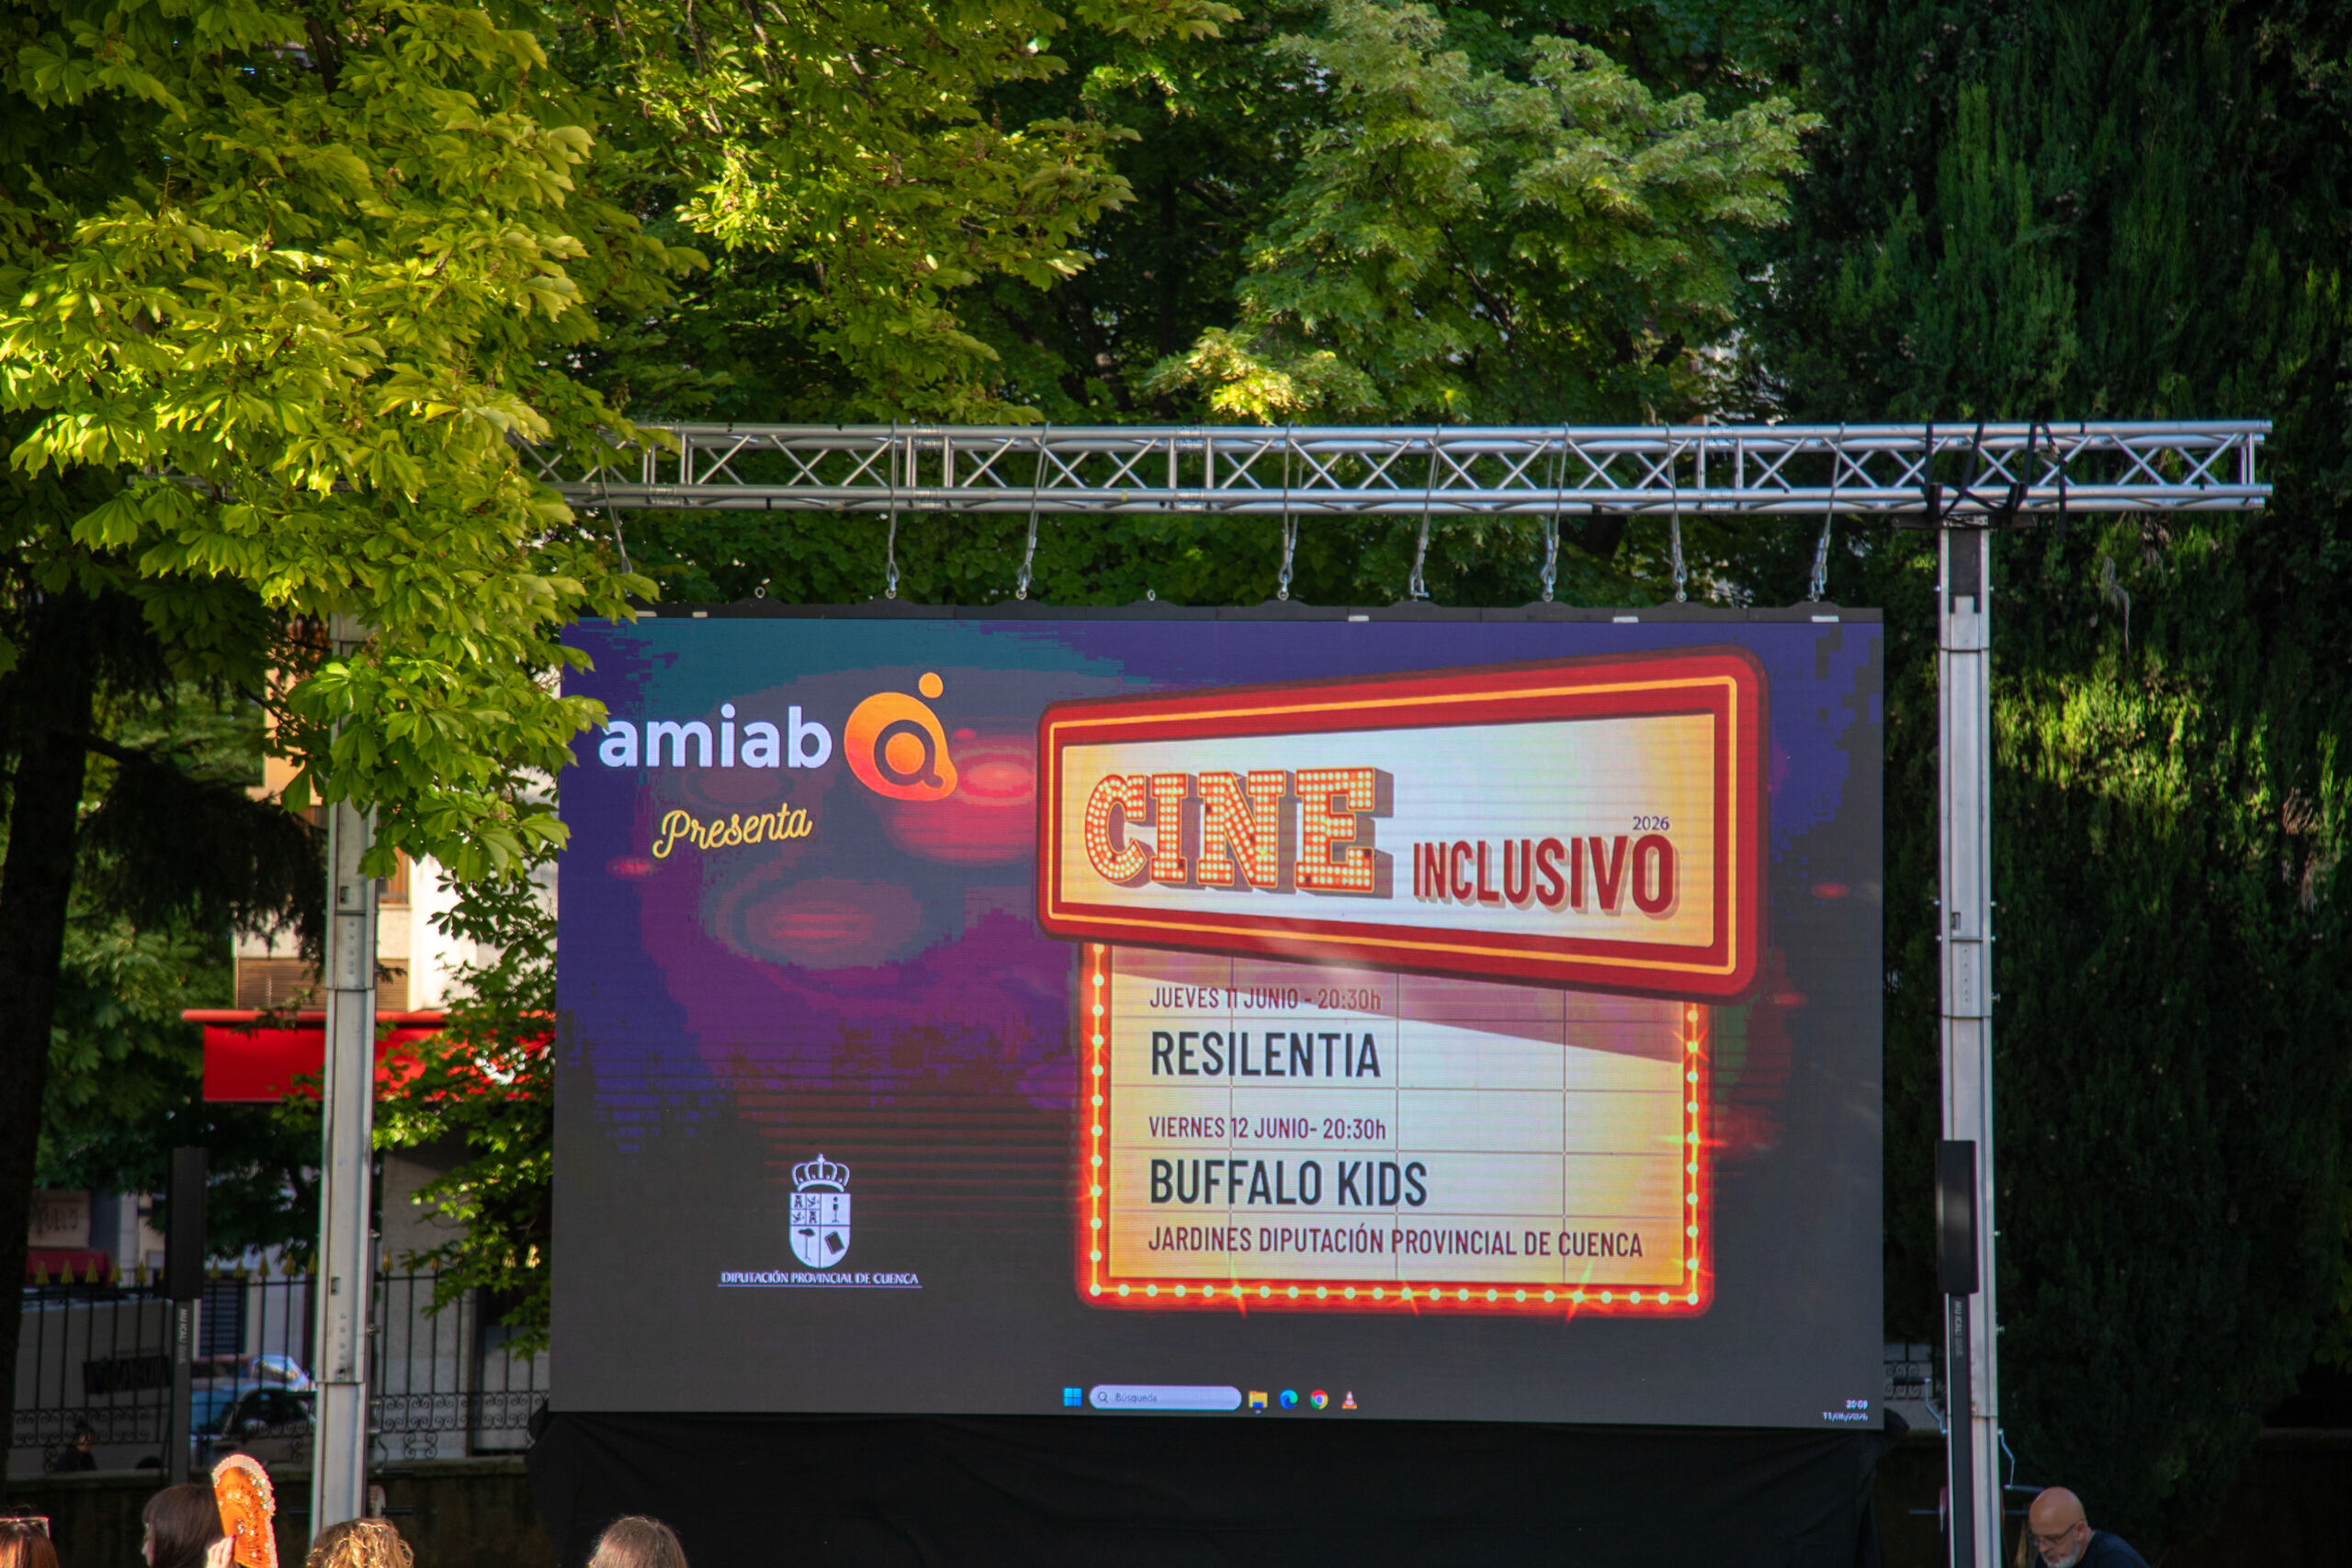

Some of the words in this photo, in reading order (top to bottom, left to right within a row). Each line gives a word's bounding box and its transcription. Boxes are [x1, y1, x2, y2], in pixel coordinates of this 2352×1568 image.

[599, 703, 832, 768] amiab
[652, 803, 813, 859] Presenta
[1084, 766, 1393, 897] CINE
[1413, 834, 1679, 915] INCLUSIVO
[1633, 816, 1670, 831] 2026
[1149, 987, 1221, 1009] JUEVES
[1225, 987, 1241, 1010] 11
[1244, 988, 1298, 1010] JUNIO
[1317, 989, 1382, 1010] 20:30h
[1151, 1031, 1381, 1078] RESILENTIA
[1149, 1116, 1226, 1139] VIERNES
[1231, 1117, 1250, 1139] 12
[1323, 1118, 1386, 1140] 20:30h
[1150, 1158, 1322, 1205] BUFFALO
[1338, 1160, 1427, 1207] KIDS
[1148, 1227, 1251, 1252] JARDINES
[1259, 1223, 1383, 1254] DIPUTACIÓN
[1391, 1230, 1518, 1256] PROVINCIAL
[1524, 1233, 1551, 1256] DE
[1558, 1233, 1643, 1258] CUENCA
[720, 1270, 788, 1284] DIPUTACIÓN
[791, 1272, 854, 1284] PROVINCIAL
[855, 1273, 871, 1284] DE
[873, 1273, 919, 1285] CUENCA
